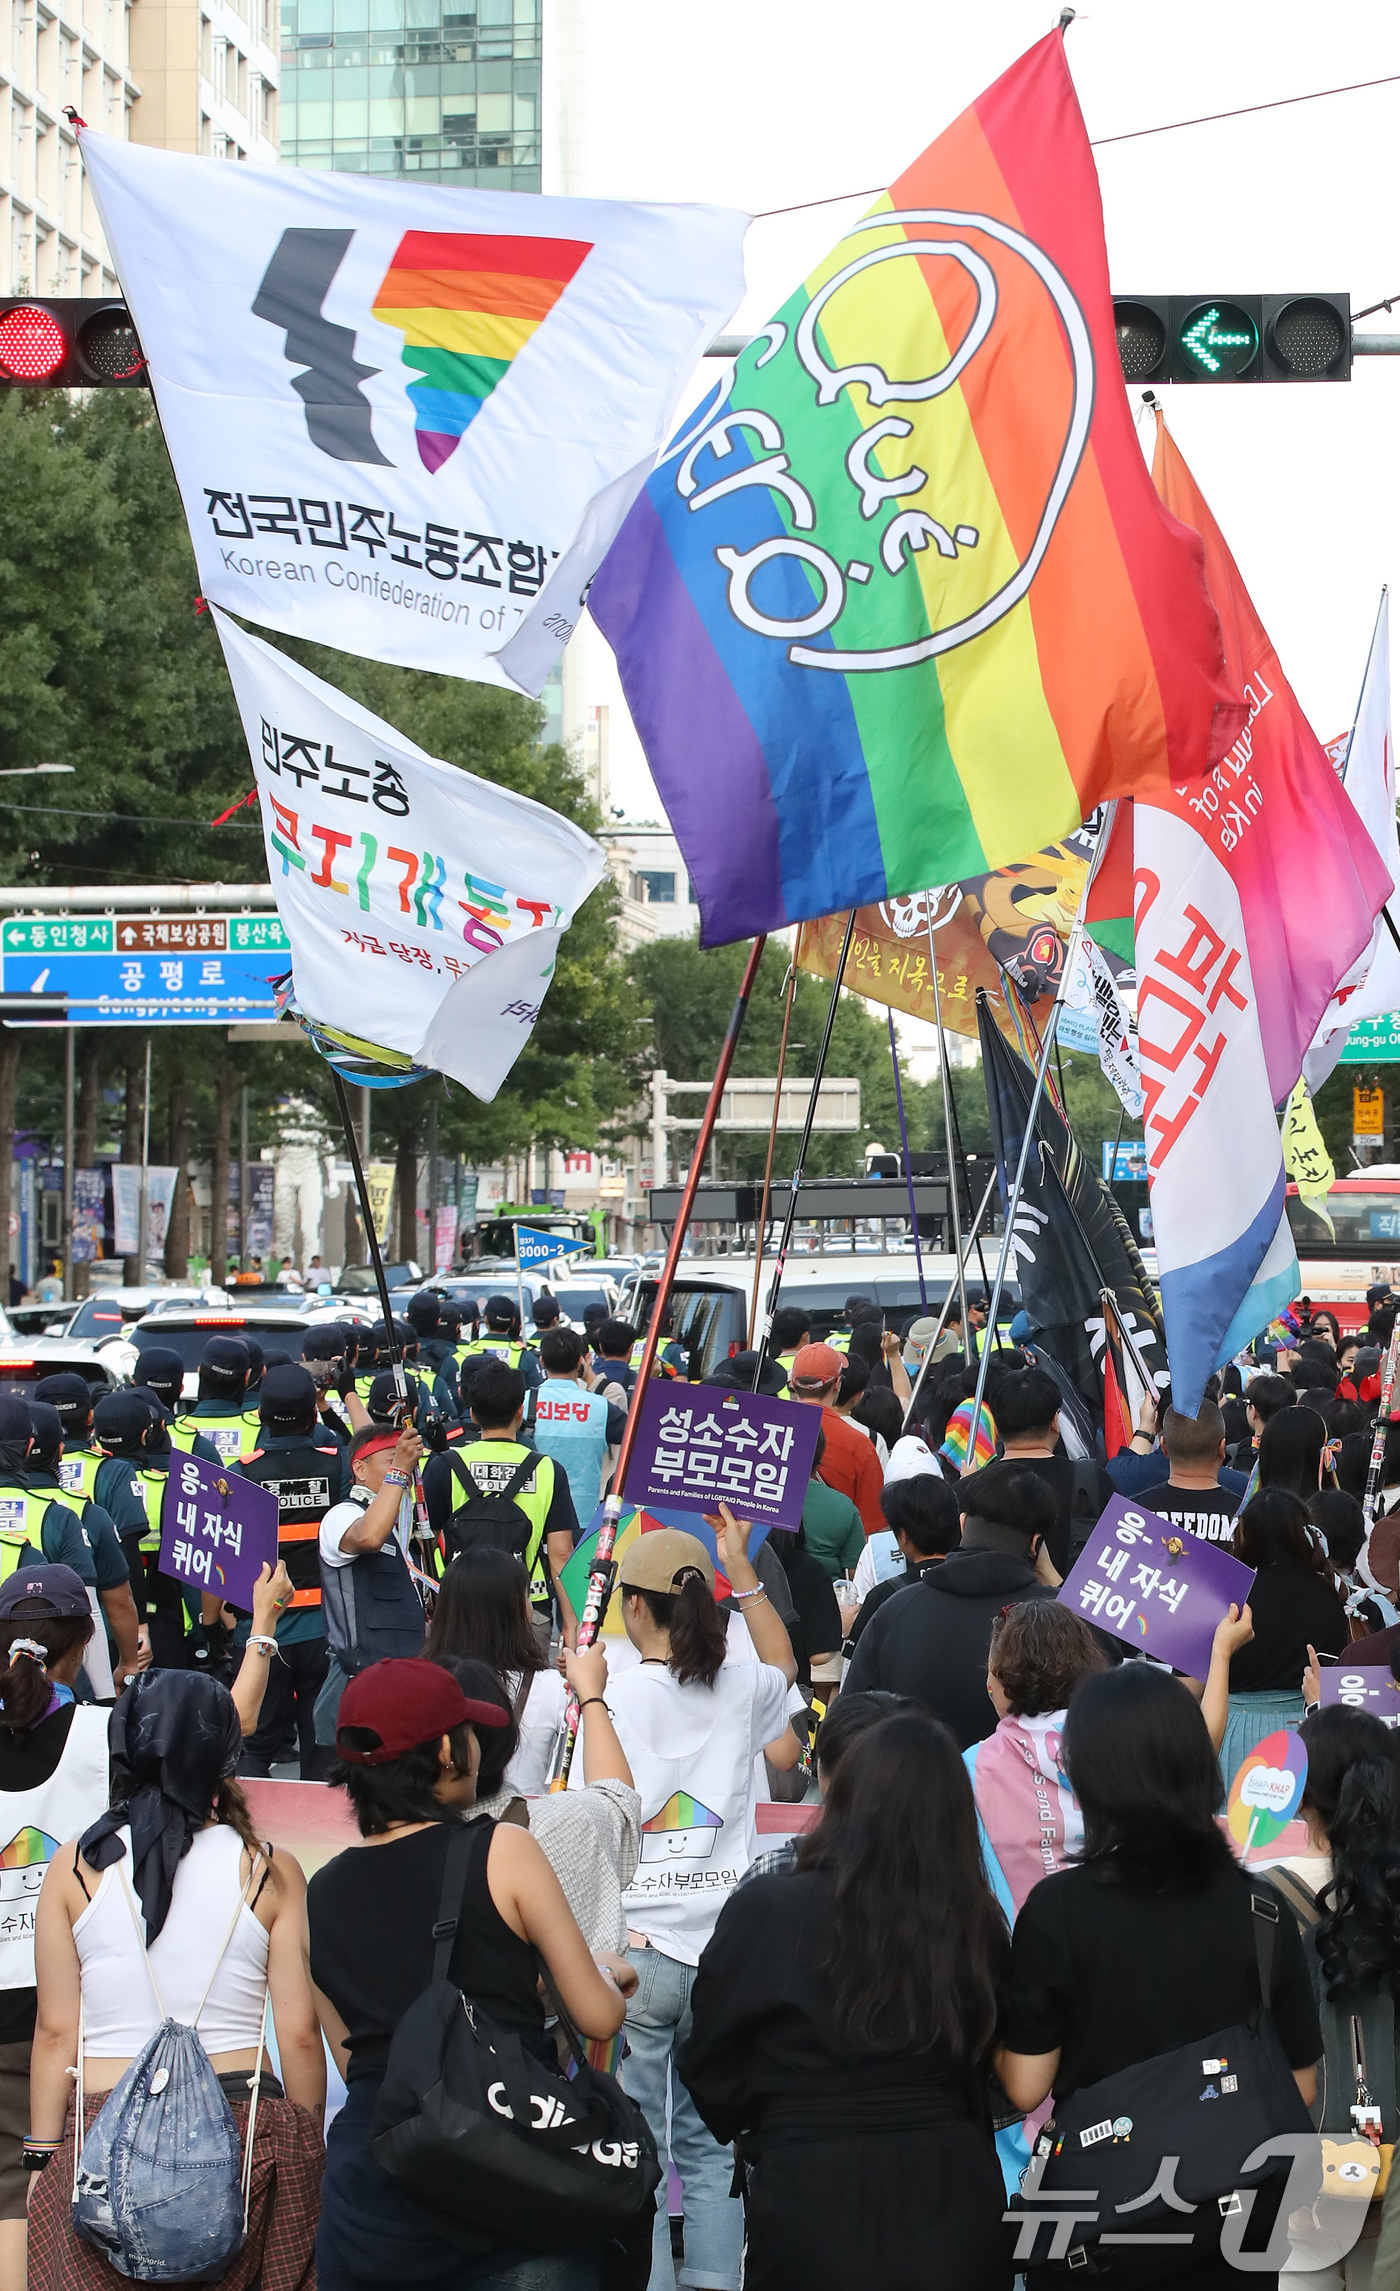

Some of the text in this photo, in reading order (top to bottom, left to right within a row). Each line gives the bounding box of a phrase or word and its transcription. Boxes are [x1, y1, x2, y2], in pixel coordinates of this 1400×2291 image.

[203, 487, 560, 597] 전국민주노동조합
[219, 548, 315, 584] Korean
[325, 560, 470, 628] Confederation
[479, 604, 507, 631] of
[260, 713, 411, 817] 민주노총
[268, 791, 444, 931] 무지개
[29, 924, 109, 948] 동인청사
[141, 923, 226, 948] 국채보상공원
[235, 922, 291, 945] 봉산육
[519, 1244, 565, 1258] 3000-2
[536, 1401, 590, 1422] 진보당
[658, 1407, 795, 1461] 성소수자
[648, 1486, 669, 1496] Parents
[669, 1488, 680, 1496] and
[681, 1489, 703, 1499] Families
[651, 1447, 788, 1502] 부모모임
[279, 1496, 323, 1508] OLICE
[176, 1501, 243, 1557] 내 자식
[172, 1539, 213, 1585] 퀴어
[1096, 1545, 1189, 1614] 내 자식
[1079, 1578, 1137, 1631] 퀴어
[1035, 1789, 1056, 1822] and
